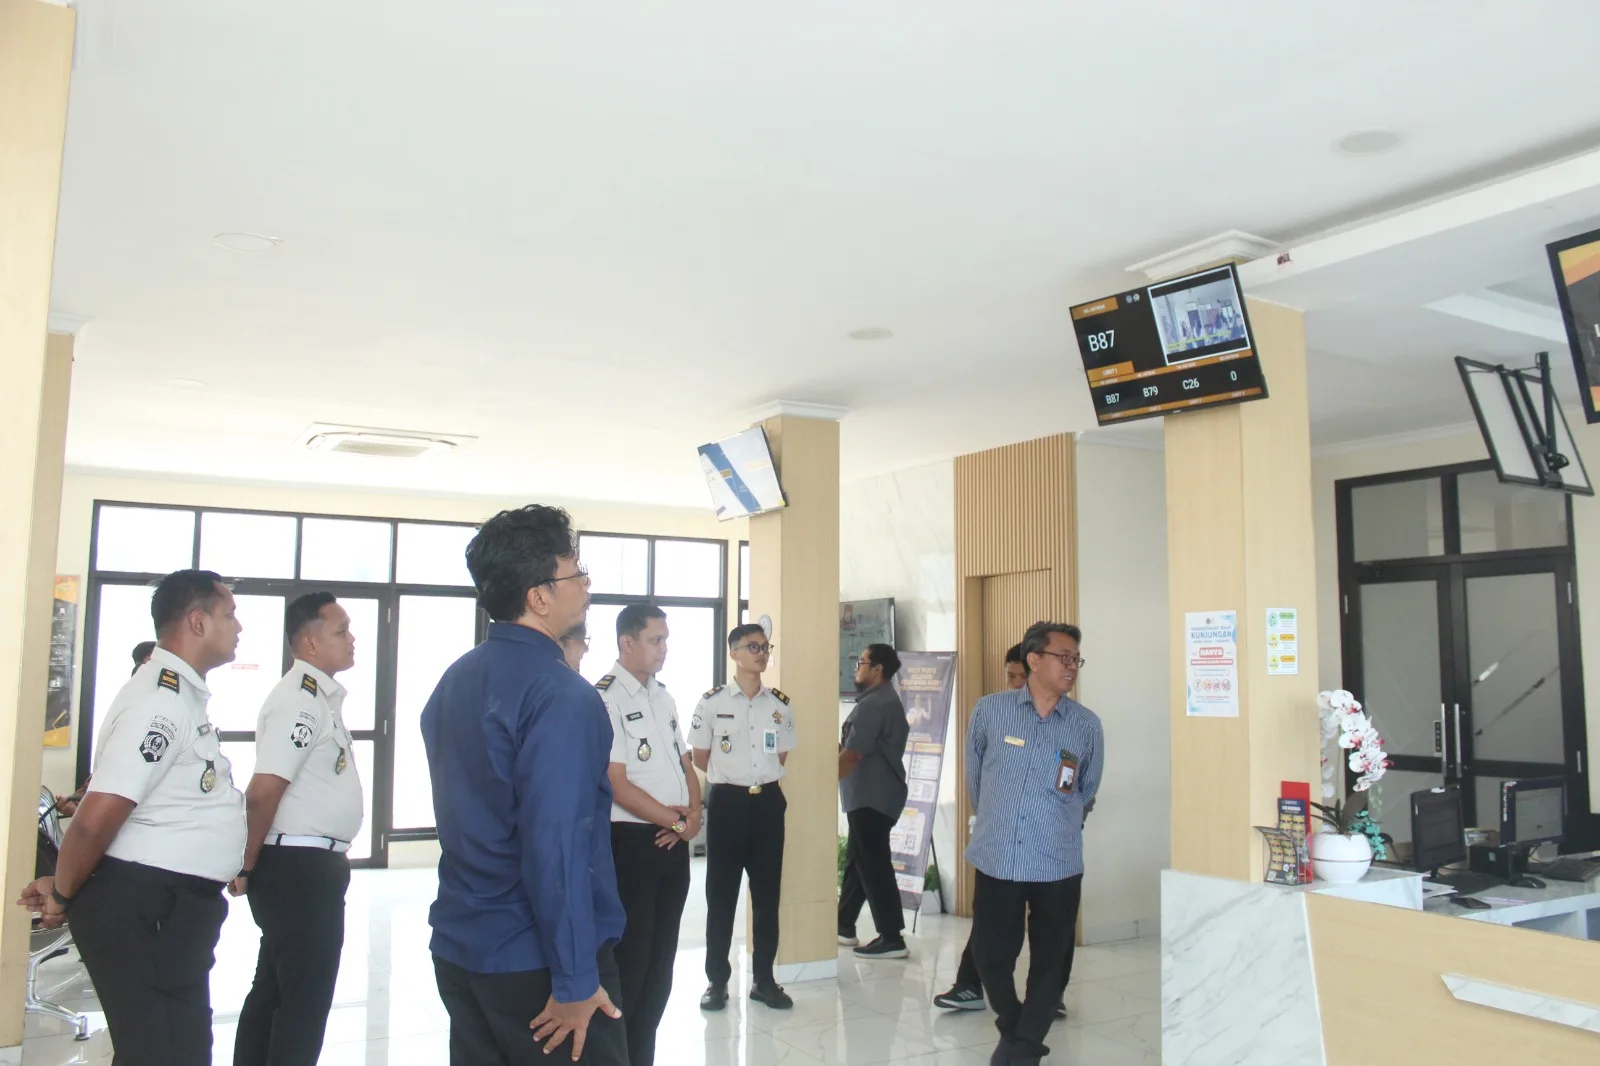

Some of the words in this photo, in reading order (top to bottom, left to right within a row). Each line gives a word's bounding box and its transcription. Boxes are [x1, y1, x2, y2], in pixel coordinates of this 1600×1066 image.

[1088, 329, 1115, 352] B87
[1182, 378, 1200, 390] C26
[1143, 385, 1159, 398] B79
[1105, 393, 1120, 405] B87
[1191, 630, 1232, 640] KUNJUNGAN
